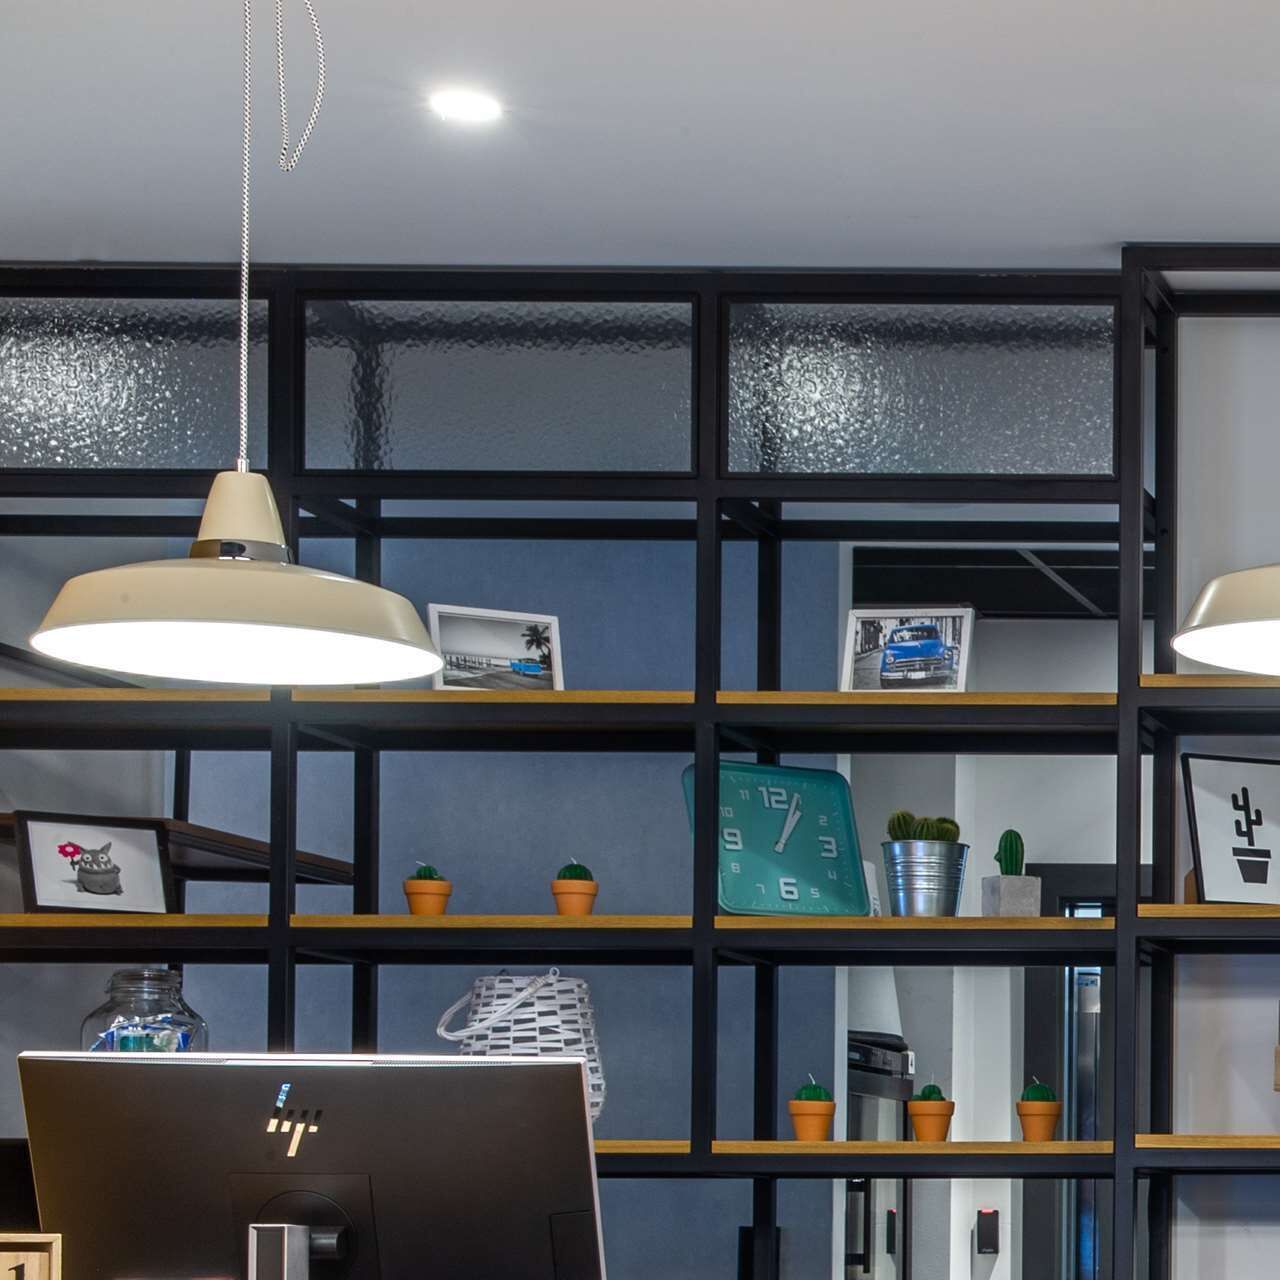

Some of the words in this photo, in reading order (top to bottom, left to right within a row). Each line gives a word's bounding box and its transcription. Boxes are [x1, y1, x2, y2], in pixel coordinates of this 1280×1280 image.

[739, 789, 750, 800] 11
[758, 786, 790, 809] 12
[818, 815, 828, 826] 2
[722, 828, 743, 850] 9
[818, 836, 838, 859] 3
[731, 862, 741, 873] 8
[779, 877, 799, 900] 6
[810, 887, 820, 898] 5
